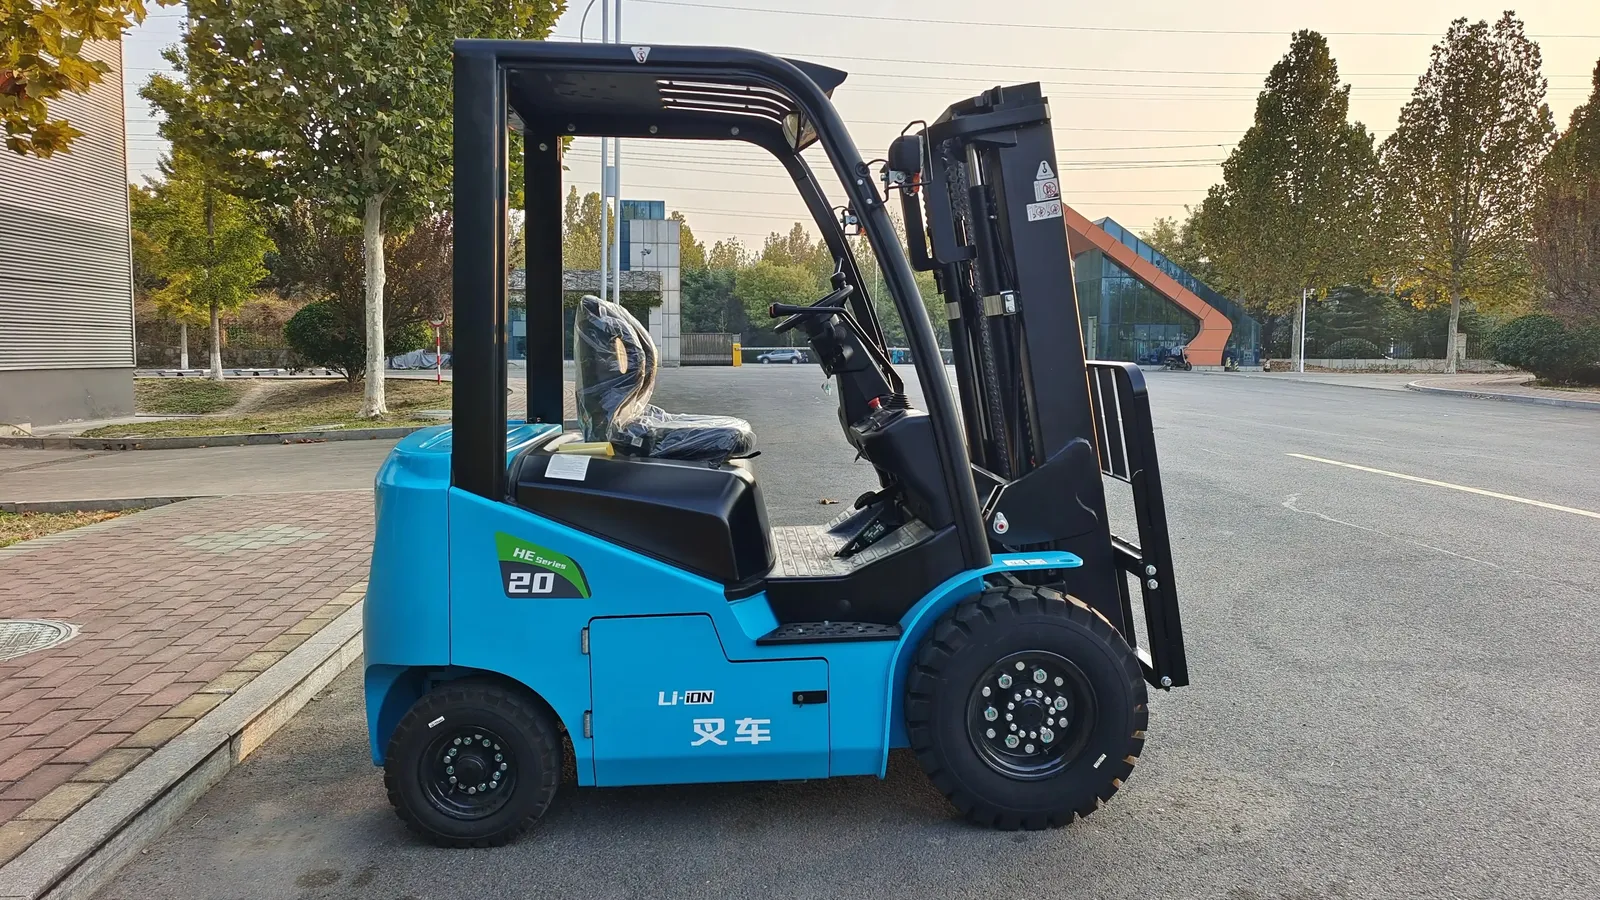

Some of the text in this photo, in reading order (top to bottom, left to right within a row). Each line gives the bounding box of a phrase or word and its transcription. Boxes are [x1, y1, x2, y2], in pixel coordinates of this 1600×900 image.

[513, 547, 566, 570] HE Series
[508, 572, 555, 593] 20
[690, 717, 771, 746] 叉车
